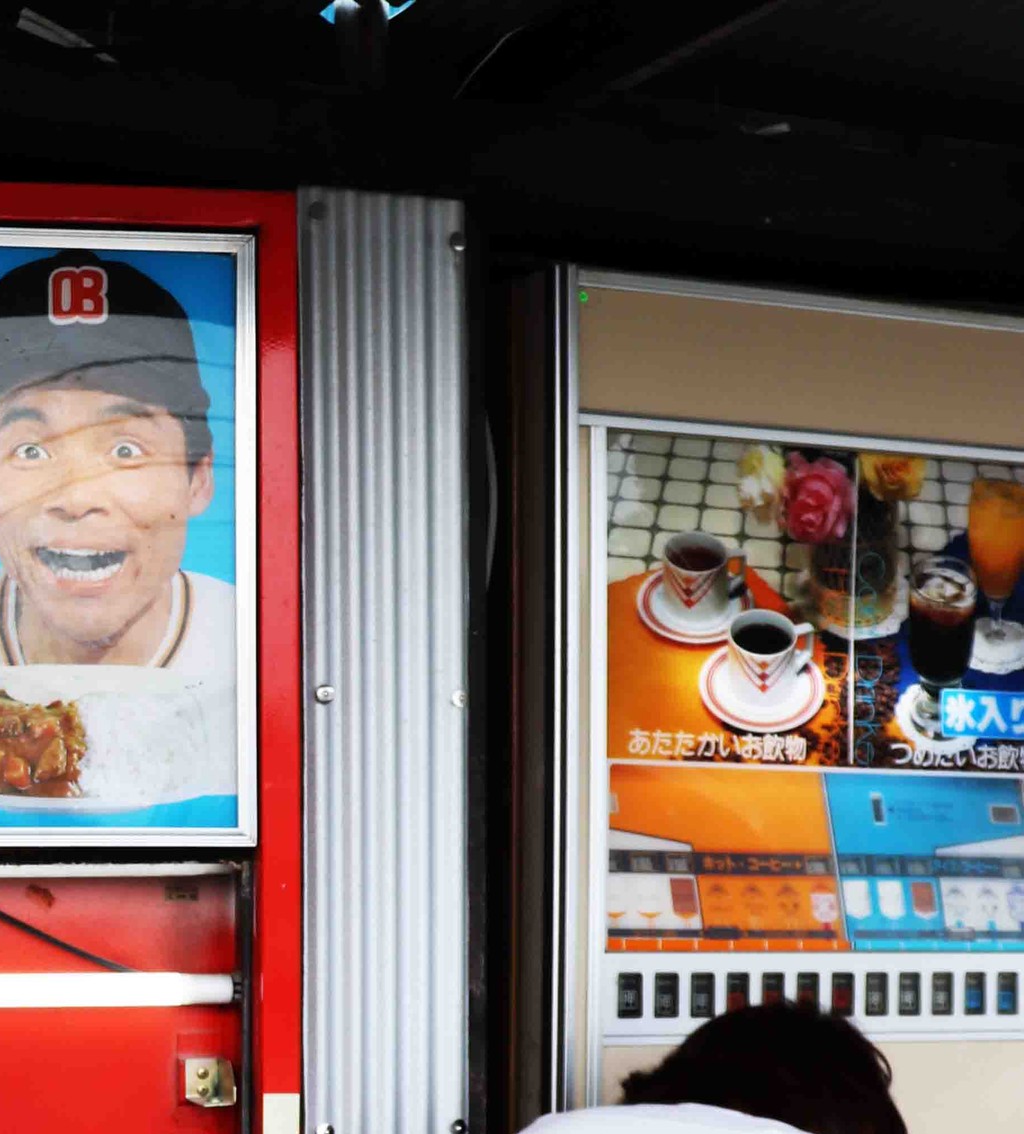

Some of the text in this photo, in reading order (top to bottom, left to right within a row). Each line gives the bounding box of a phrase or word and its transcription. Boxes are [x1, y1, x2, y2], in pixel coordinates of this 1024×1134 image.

[48, 266, 108, 325] OB
[628, 728, 808, 762] あたたかいお飲物
[891, 742, 1024, 771] つめたいお飲
